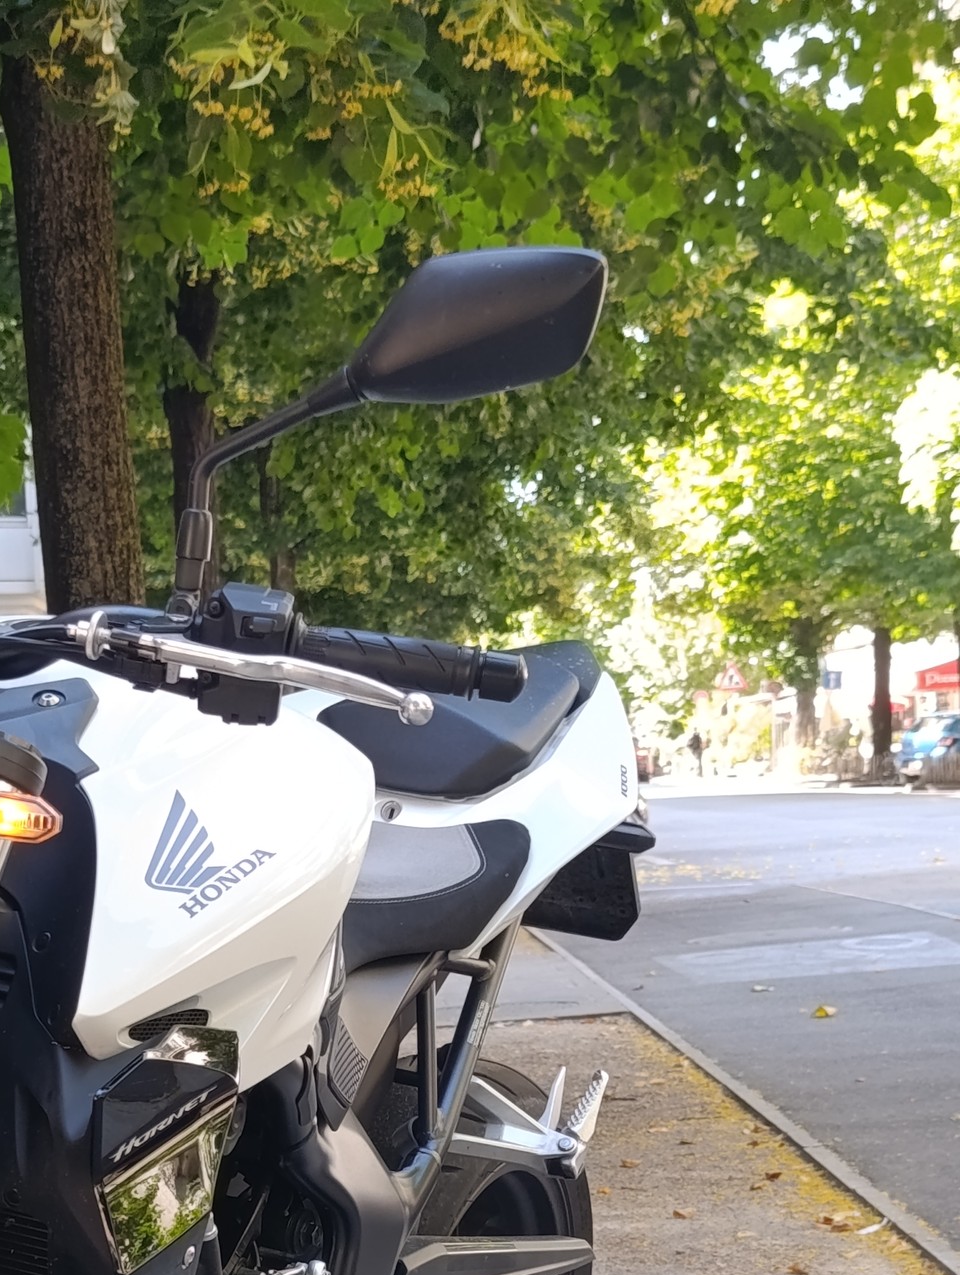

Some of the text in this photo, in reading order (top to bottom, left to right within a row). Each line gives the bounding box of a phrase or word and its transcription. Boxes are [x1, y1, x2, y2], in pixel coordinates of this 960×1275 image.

[620, 764, 628, 798] 1000
[178, 849, 277, 918] HONDA
[109, 1085, 217, 1163] HORNET
